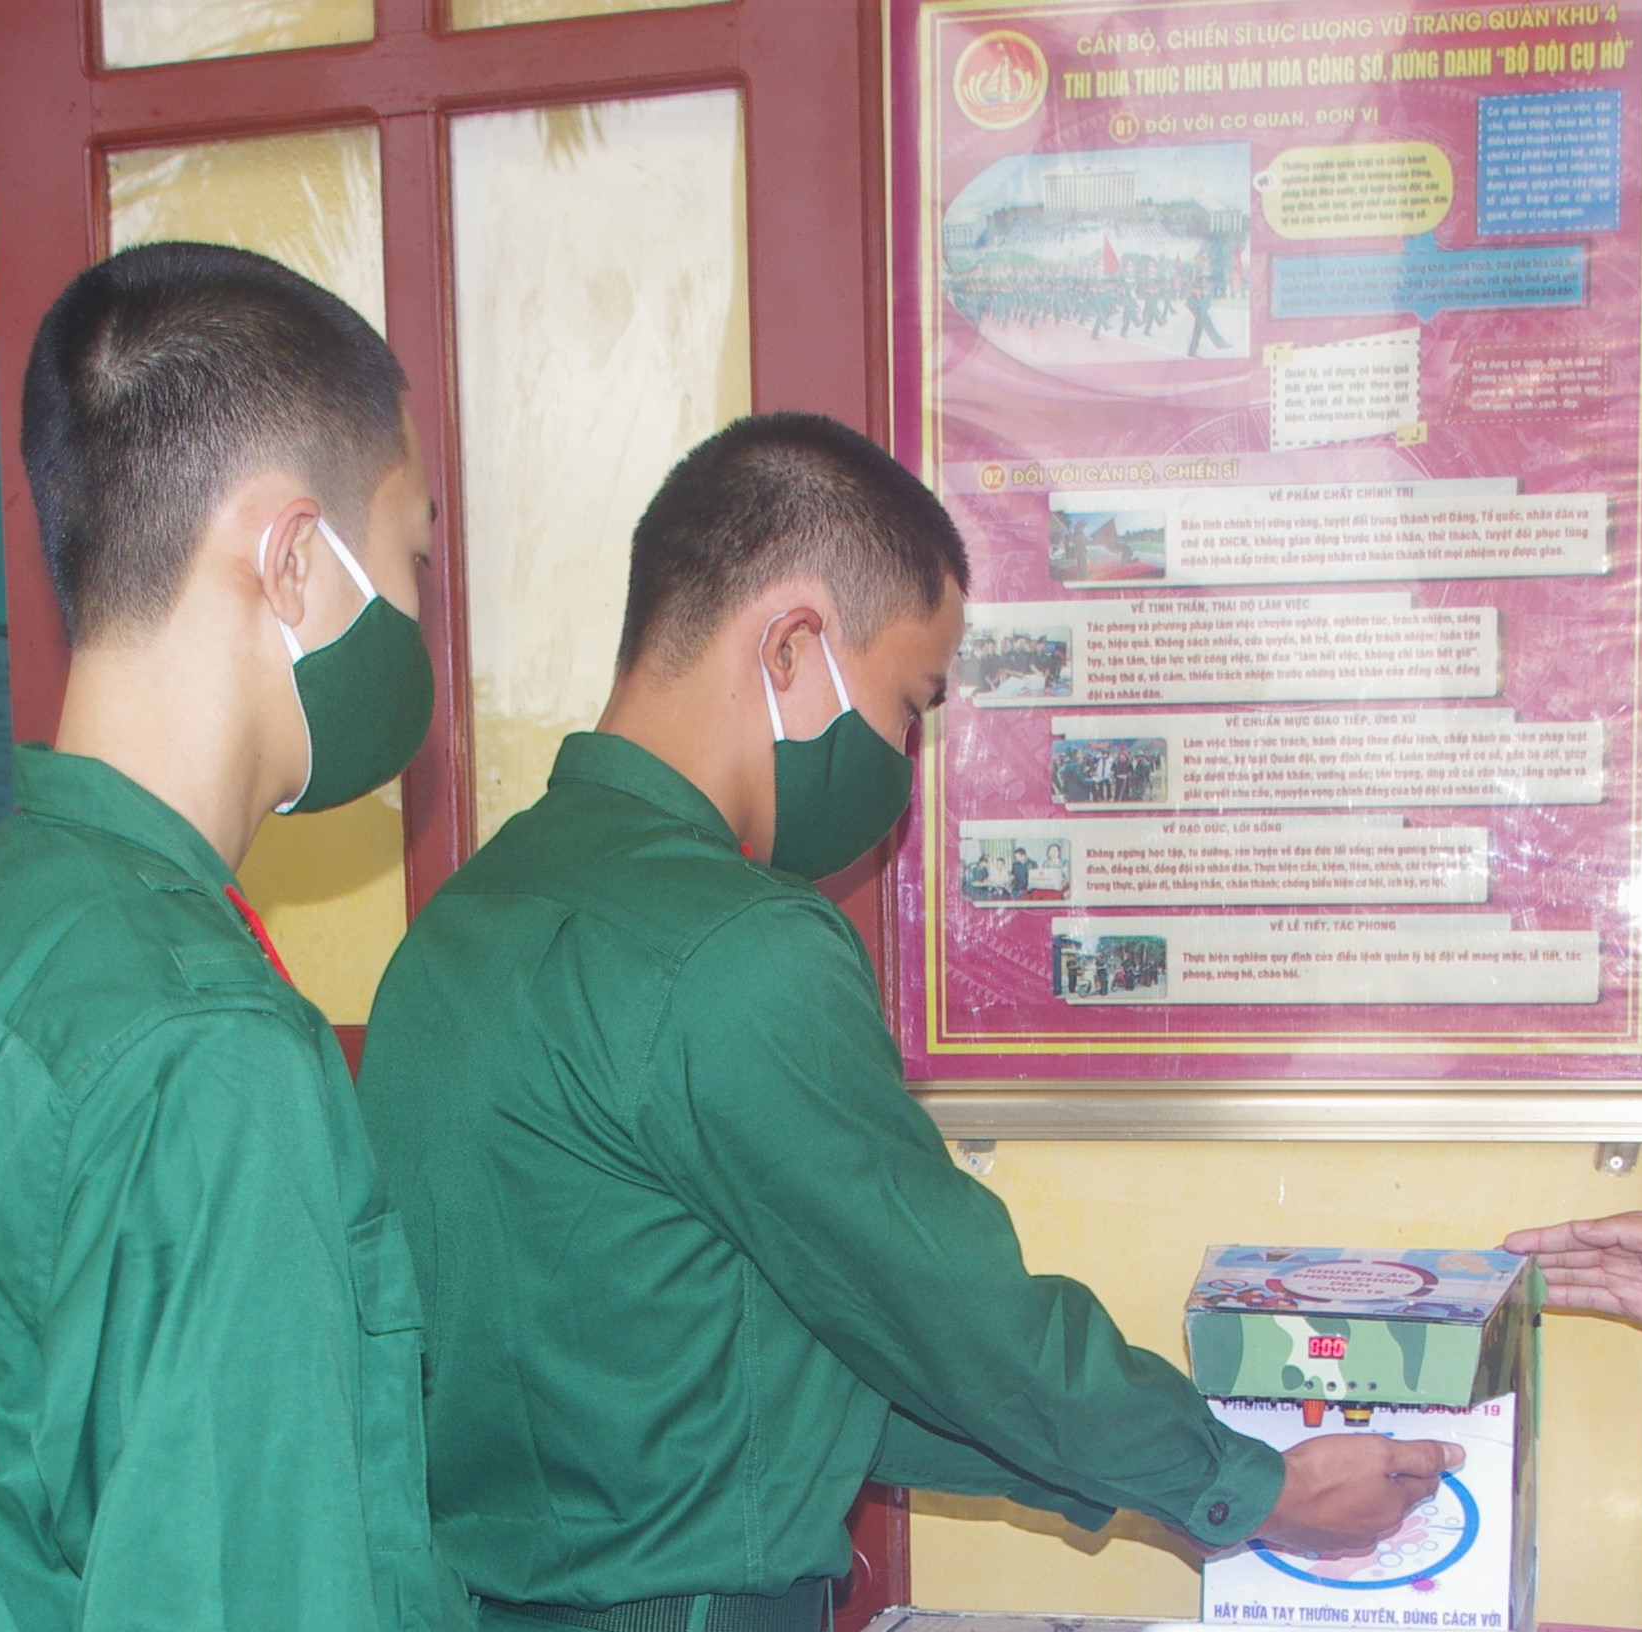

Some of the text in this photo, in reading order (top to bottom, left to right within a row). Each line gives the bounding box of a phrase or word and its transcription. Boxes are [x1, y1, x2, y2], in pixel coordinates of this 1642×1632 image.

[1076, 4, 1618, 57] CÁN BỘ, CHIẾN SĨ LỰC LƯỢNG VŨ TRANG QUÂN KHU 4
[1063, 71, 1091, 100] THI
[1096, 69, 1131, 98] ĐUA
[1134, 64, 1180, 99] THỰC
[1184, 61, 1224, 96] HIỆN
[1227, 58, 1262, 91] VĂN
[1266, 56, 1303, 87] HÓA
[1307, 53, 1354, 86] CÔNG
[1360, 47, 1388, 83] SỞ,
[1390, 47, 1439, 80] XỨNG
[1444, 46, 1492, 76] DANH
[1533, 39, 1565, 77] ĐỘI
[1570, 41, 1596, 76] CỤ
[1115, 106, 1379, 136] 01 ĐỐI VỚI CƠ QUAN, ĐƠN VỊ
[1214, 1599, 1502, 1627] HÃY RỬA TAY THƯỜNG XUYÊN, ĐÚNG CÁCH VỚI
